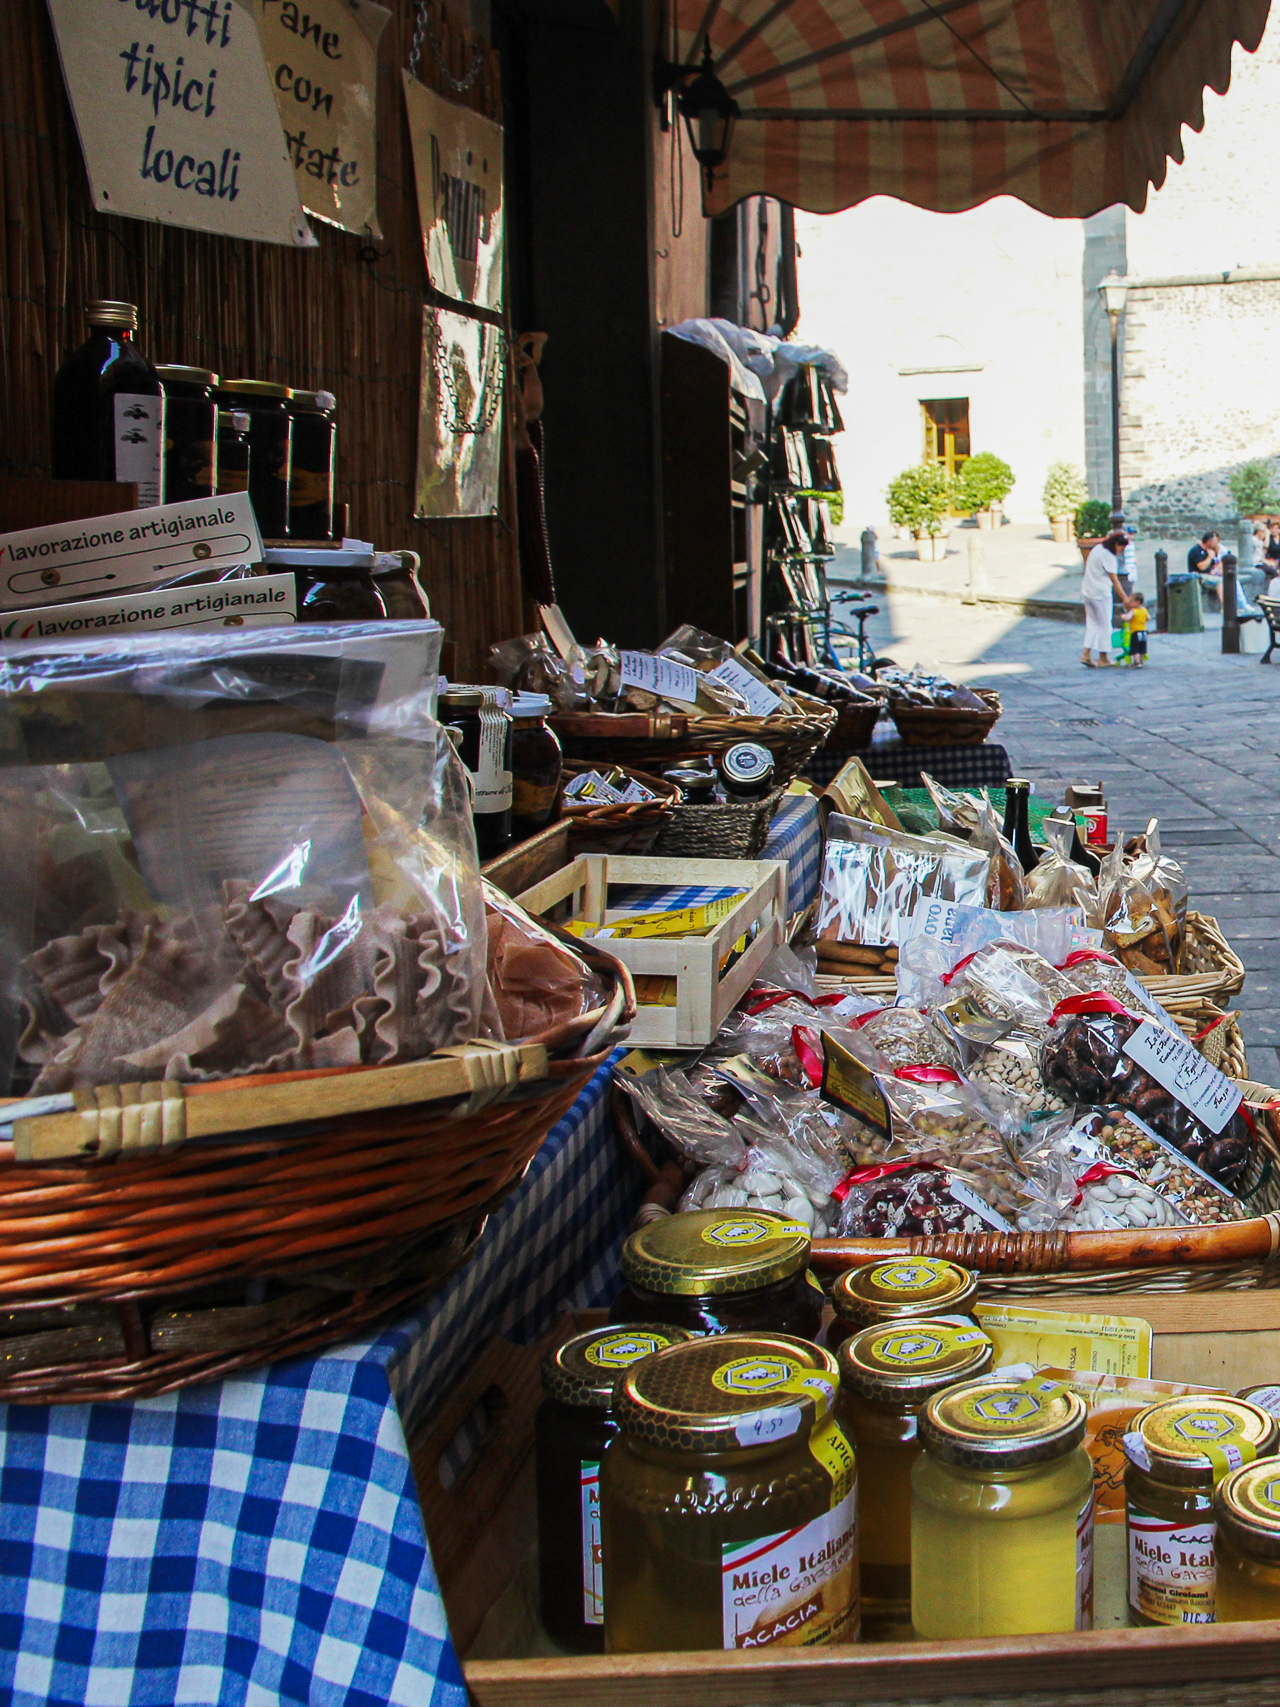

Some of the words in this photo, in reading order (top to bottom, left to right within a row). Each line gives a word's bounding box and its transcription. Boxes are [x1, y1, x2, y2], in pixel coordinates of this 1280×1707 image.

[119, 42, 217, 119] tipici
[274, 64, 333, 119] con
[140, 125, 241, 201] locali
[283, 129, 360, 187] tate
[8, 528, 125, 562] lavorazione
[129, 508, 236, 541] artigianale
[37, 604, 165, 636] lavorazione
[171, 588, 286, 616] artigianale
[732, 1564, 791, 1591] Miele
[799, 1523, 855, 1573] Italiano
[1134, 1535, 1172, 1564] Miele
[1180, 1550, 1215, 1568] Ital
[1169, 1534, 1213, 1544] ACACI
[1136, 1556, 1164, 1576] della
[734, 1584, 781, 1607] della
[742, 1604, 818, 1649] ACACIA
